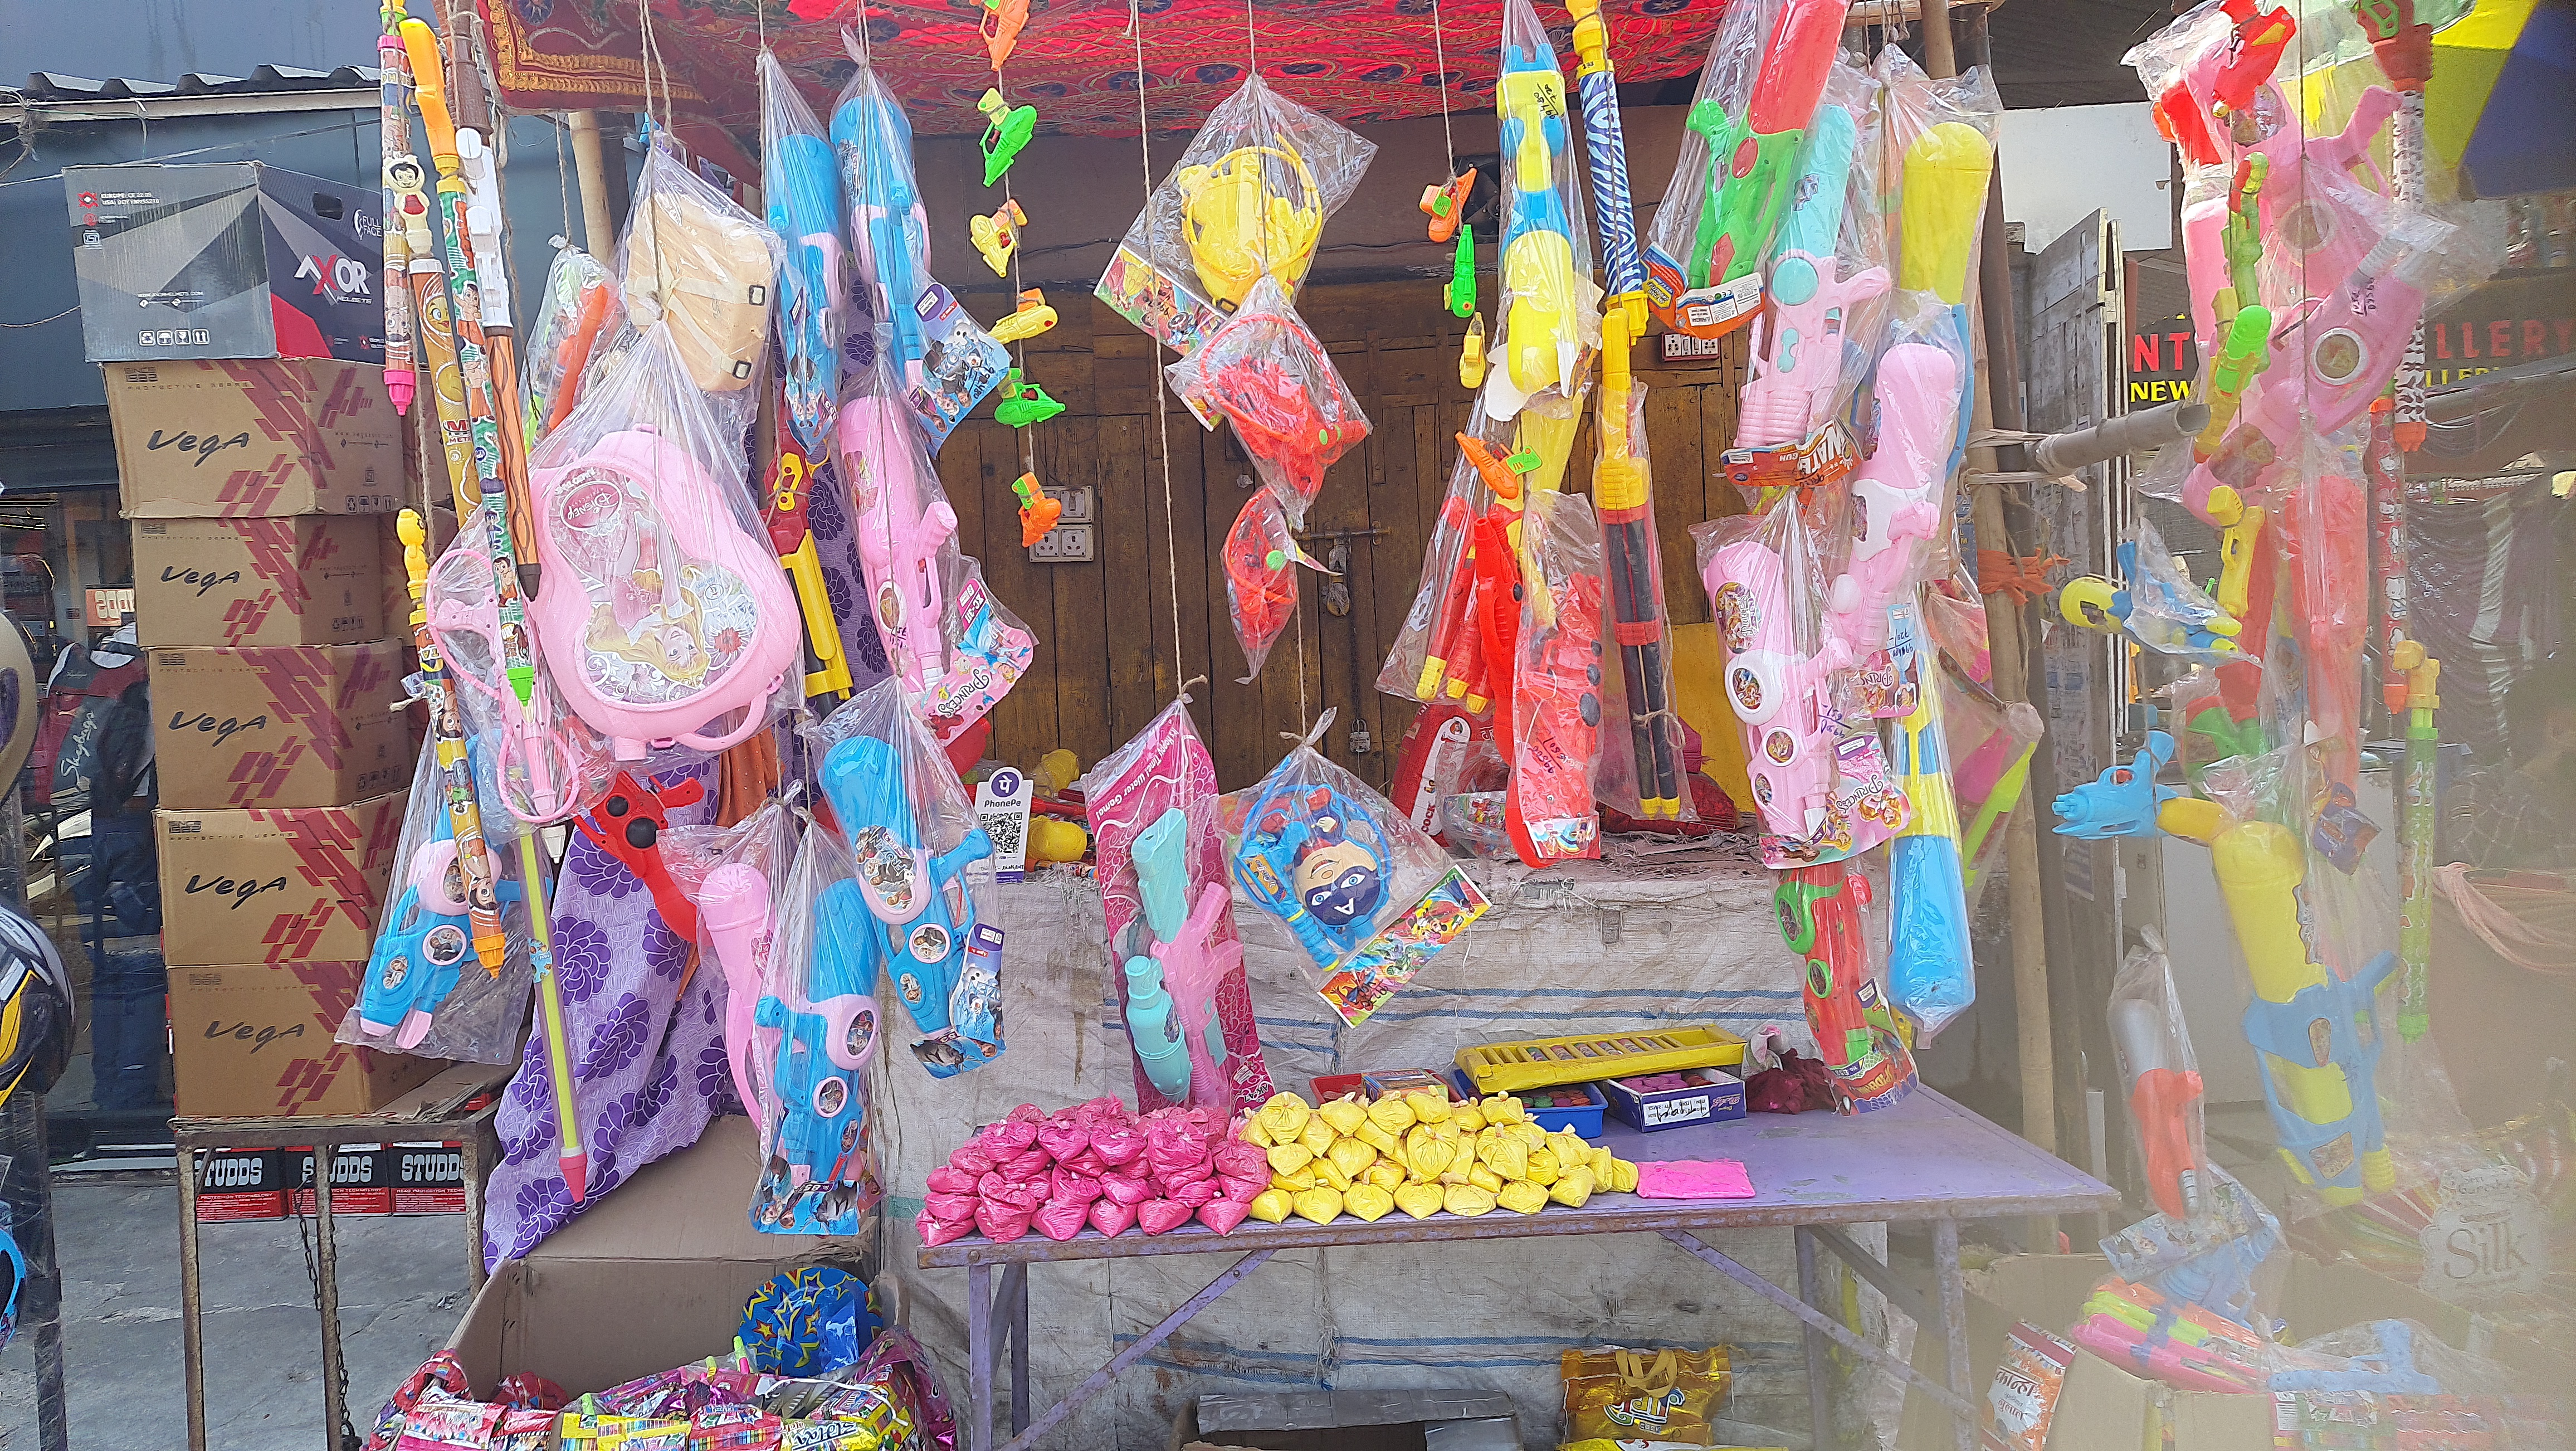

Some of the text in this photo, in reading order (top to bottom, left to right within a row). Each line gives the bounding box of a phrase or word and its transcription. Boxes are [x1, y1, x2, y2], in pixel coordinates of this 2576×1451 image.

[362, 216, 381, 227] FULL
[363, 227, 382, 237] FACE
[294, 254, 371, 305] AXOR
[2130, 381, 2189, 402] NEW
[1780, 452, 1799, 461] GUN
[938, 669, 989, 717] PRINCESS
[1157, 736, 1175, 757] Happy
[1144, 757, 1162, 777] Time!
[998, 775, 1013, 793] पे
[1124, 773, 1147, 797] Water
[1836, 774, 1883, 814] PRINCESS
[984, 799, 1021, 807] PhonePe
[1095, 795, 1123, 821] Game!
[1422, 802, 1436, 832] COCK
[870, 834, 908, 876] FROZEN
[1245, 1084, 1268, 1102] AK-47
[401, 1154, 464, 1181] STUDD
[2443, 1223, 2530, 1280] Silk
